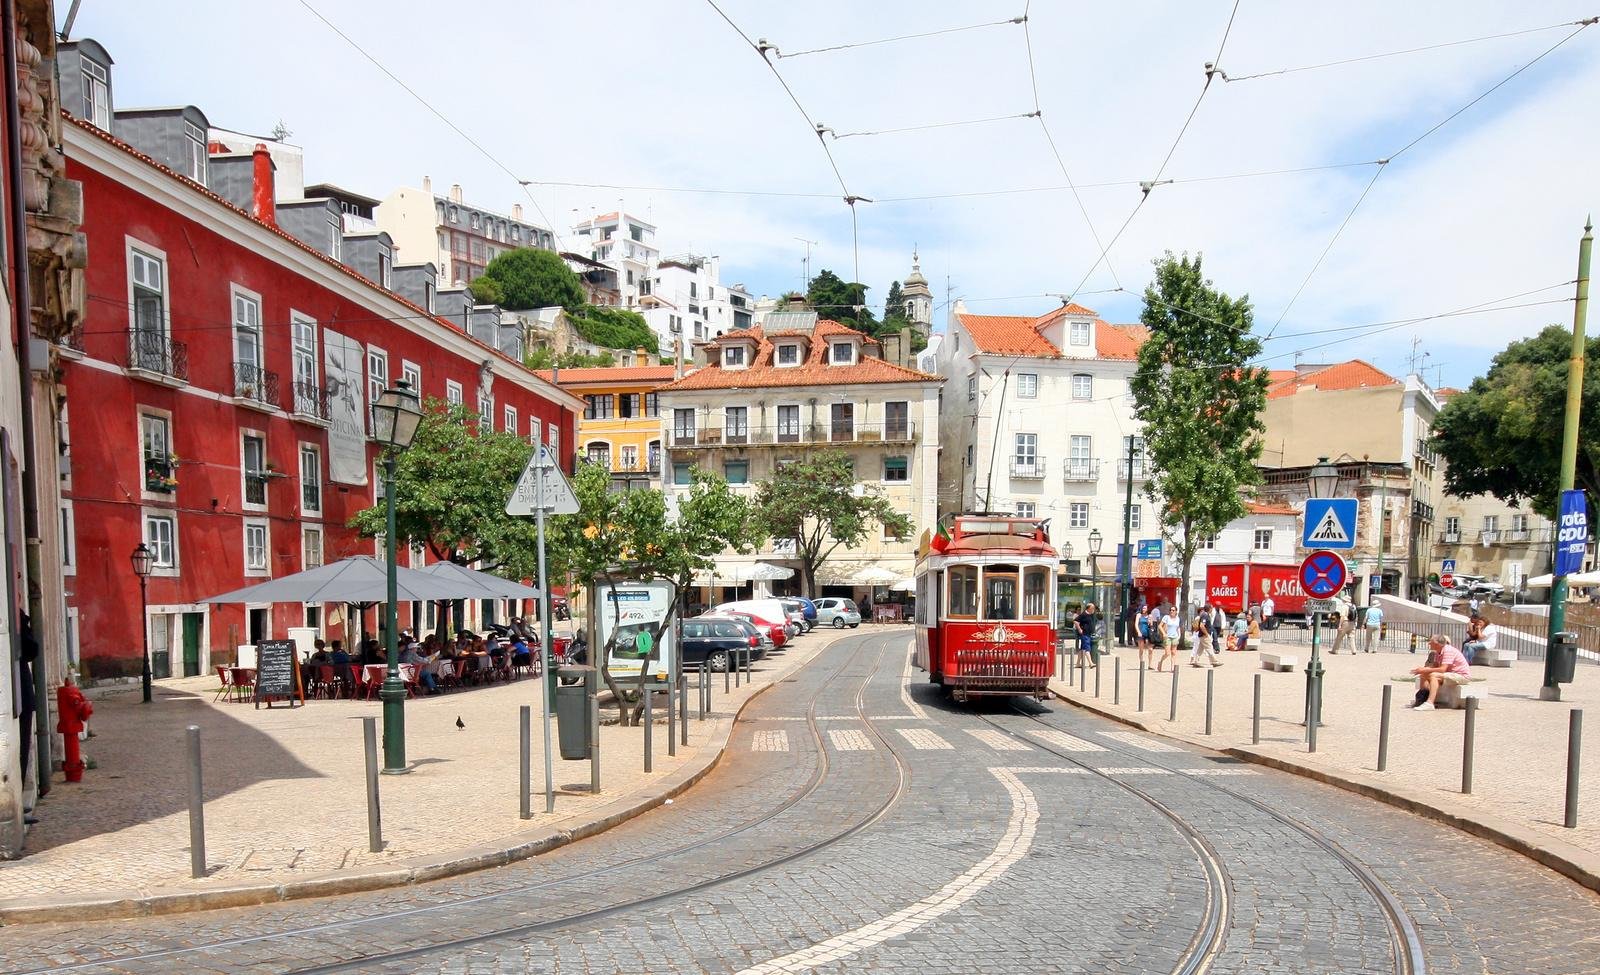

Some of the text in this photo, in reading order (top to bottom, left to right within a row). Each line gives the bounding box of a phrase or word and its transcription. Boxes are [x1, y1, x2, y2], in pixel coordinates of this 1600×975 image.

[1558, 526, 1588, 542] CDU
[1211, 586, 1238, 597] SAGRES
[1273, 578, 1309, 597] SAGR
